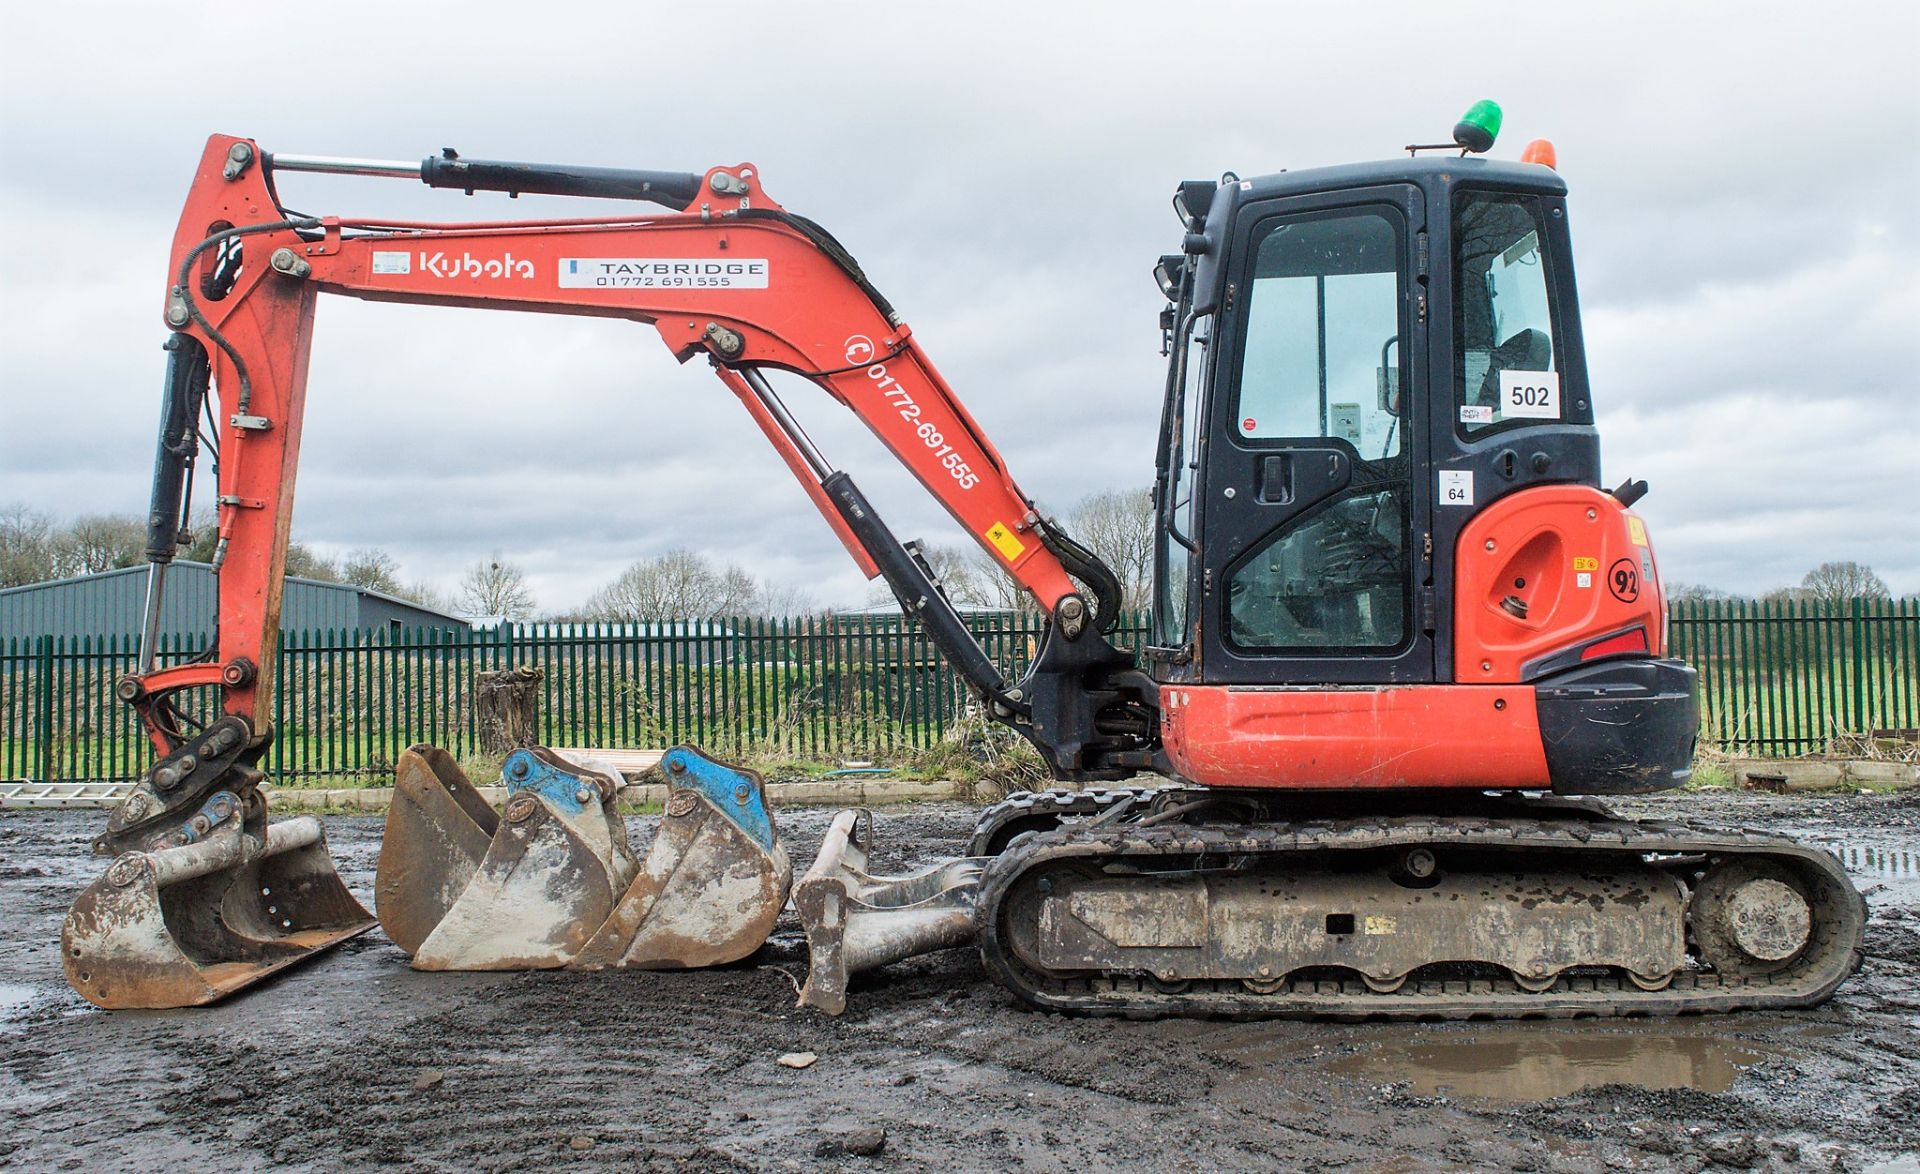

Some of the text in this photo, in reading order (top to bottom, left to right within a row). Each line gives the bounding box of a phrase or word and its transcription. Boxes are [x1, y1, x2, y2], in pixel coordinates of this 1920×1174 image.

[419, 251, 535, 279] Kubota
[600, 263, 764, 275] TAYBRIDGE
[596, 276, 731, 287] 01772 691555
[1512, 386, 1549, 406] 502
[867, 363, 981, 490] 01772-691555
[1448, 488, 1465, 501] 64
[1615, 569, 1637, 595] 92
